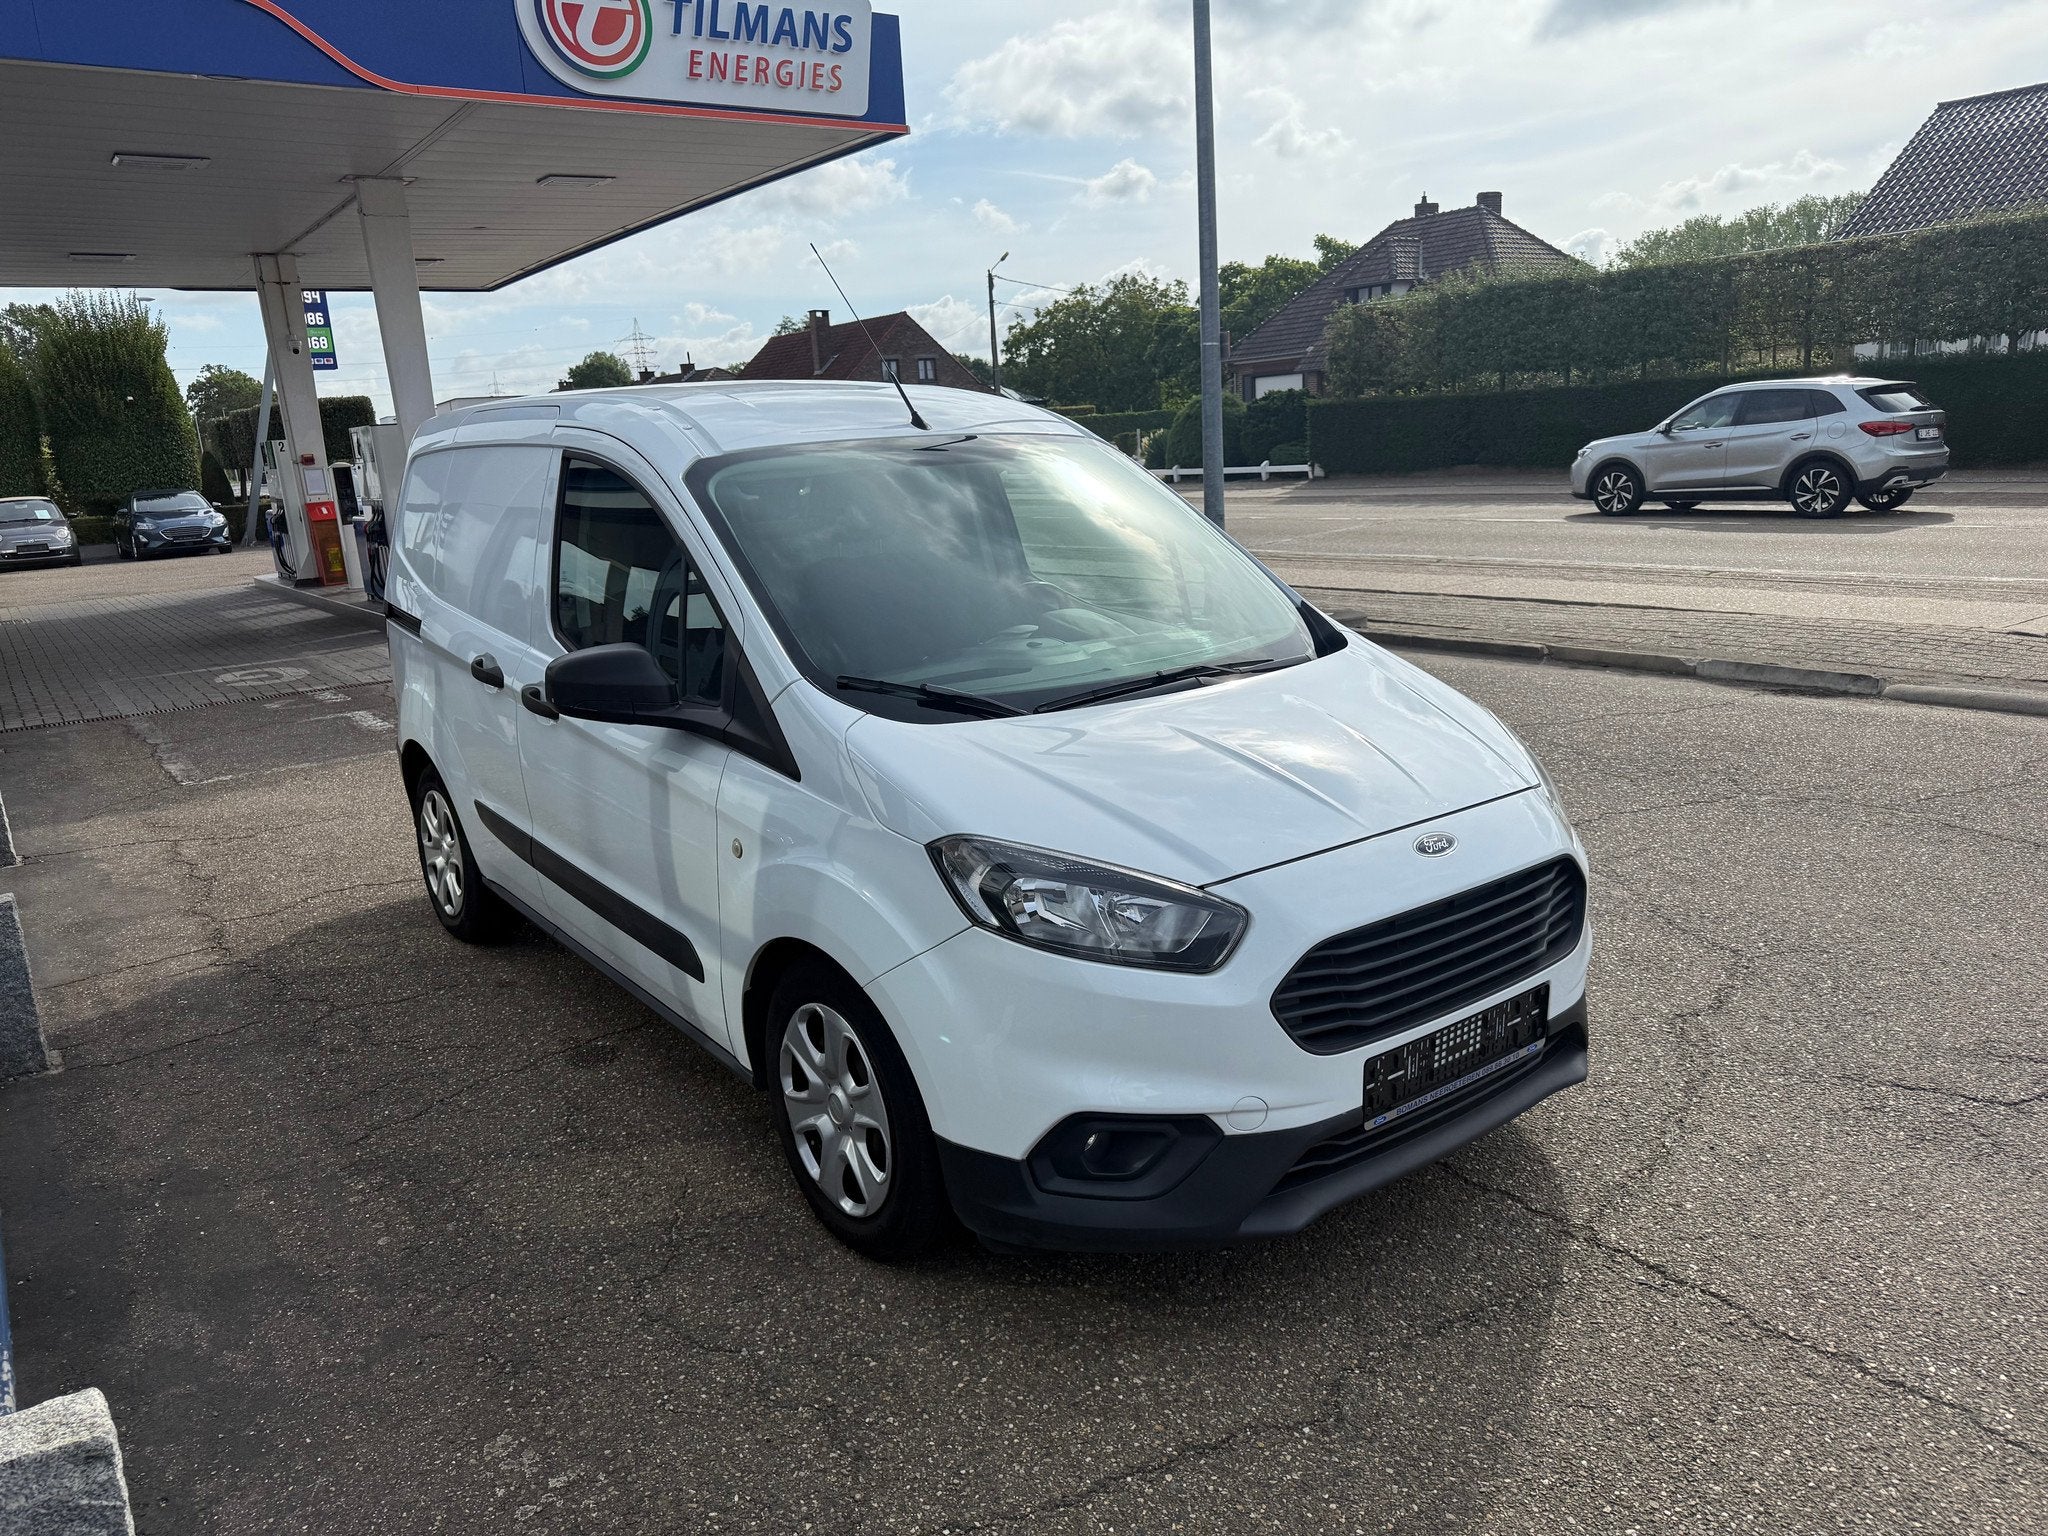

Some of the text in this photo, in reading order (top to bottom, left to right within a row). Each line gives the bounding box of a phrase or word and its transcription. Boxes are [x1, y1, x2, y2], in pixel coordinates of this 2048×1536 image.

[666, 0, 853, 53] TILMANS
[688, 50, 843, 91] ENERGIES
[301, 290, 321, 303] 94
[304, 312, 325, 325] 86
[278, 441, 286, 452] 2
[1424, 837, 1449, 852] Ford
[1396, 1095, 1428, 1115] BOMANS
